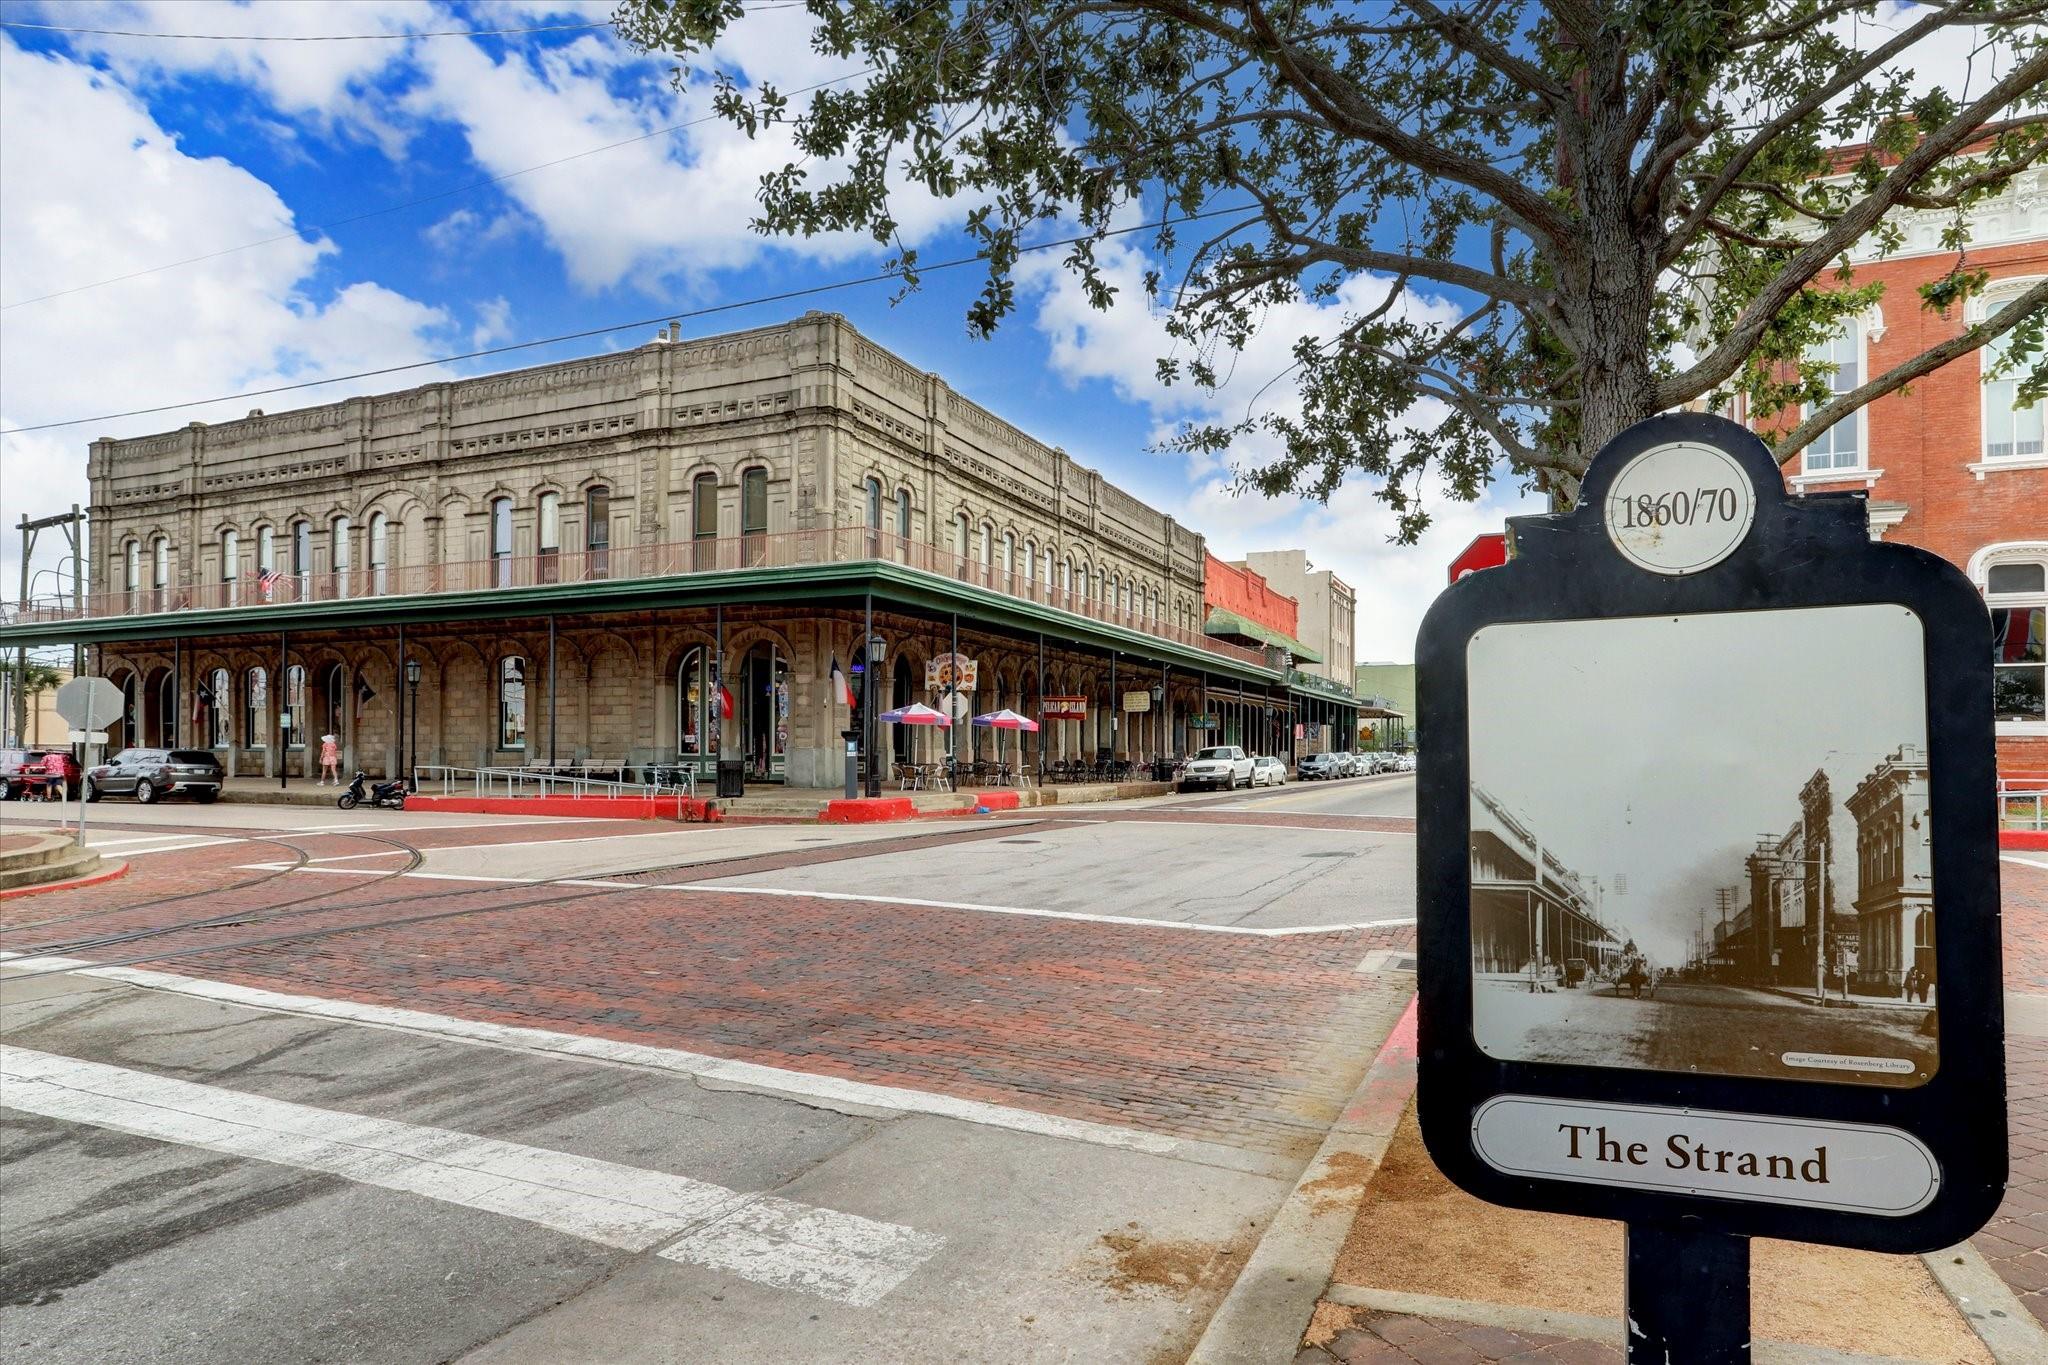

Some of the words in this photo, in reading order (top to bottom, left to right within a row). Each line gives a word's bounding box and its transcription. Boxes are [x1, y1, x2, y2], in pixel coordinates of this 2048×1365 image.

[1622, 487, 1737, 529] 1860/70
[1042, 701, 1061, 713] PELICAN
[1069, 701, 1086, 713] ISLAND
[1786, 1055, 1806, 1063] Image
[1807, 1056, 1838, 1066] Courtesy
[1848, 1059, 1883, 1068] Rosenberg
[1885, 1061, 1911, 1070] Library
[1558, 1123, 1648, 1165] The
[1665, 1134, 1830, 1184] Strand
